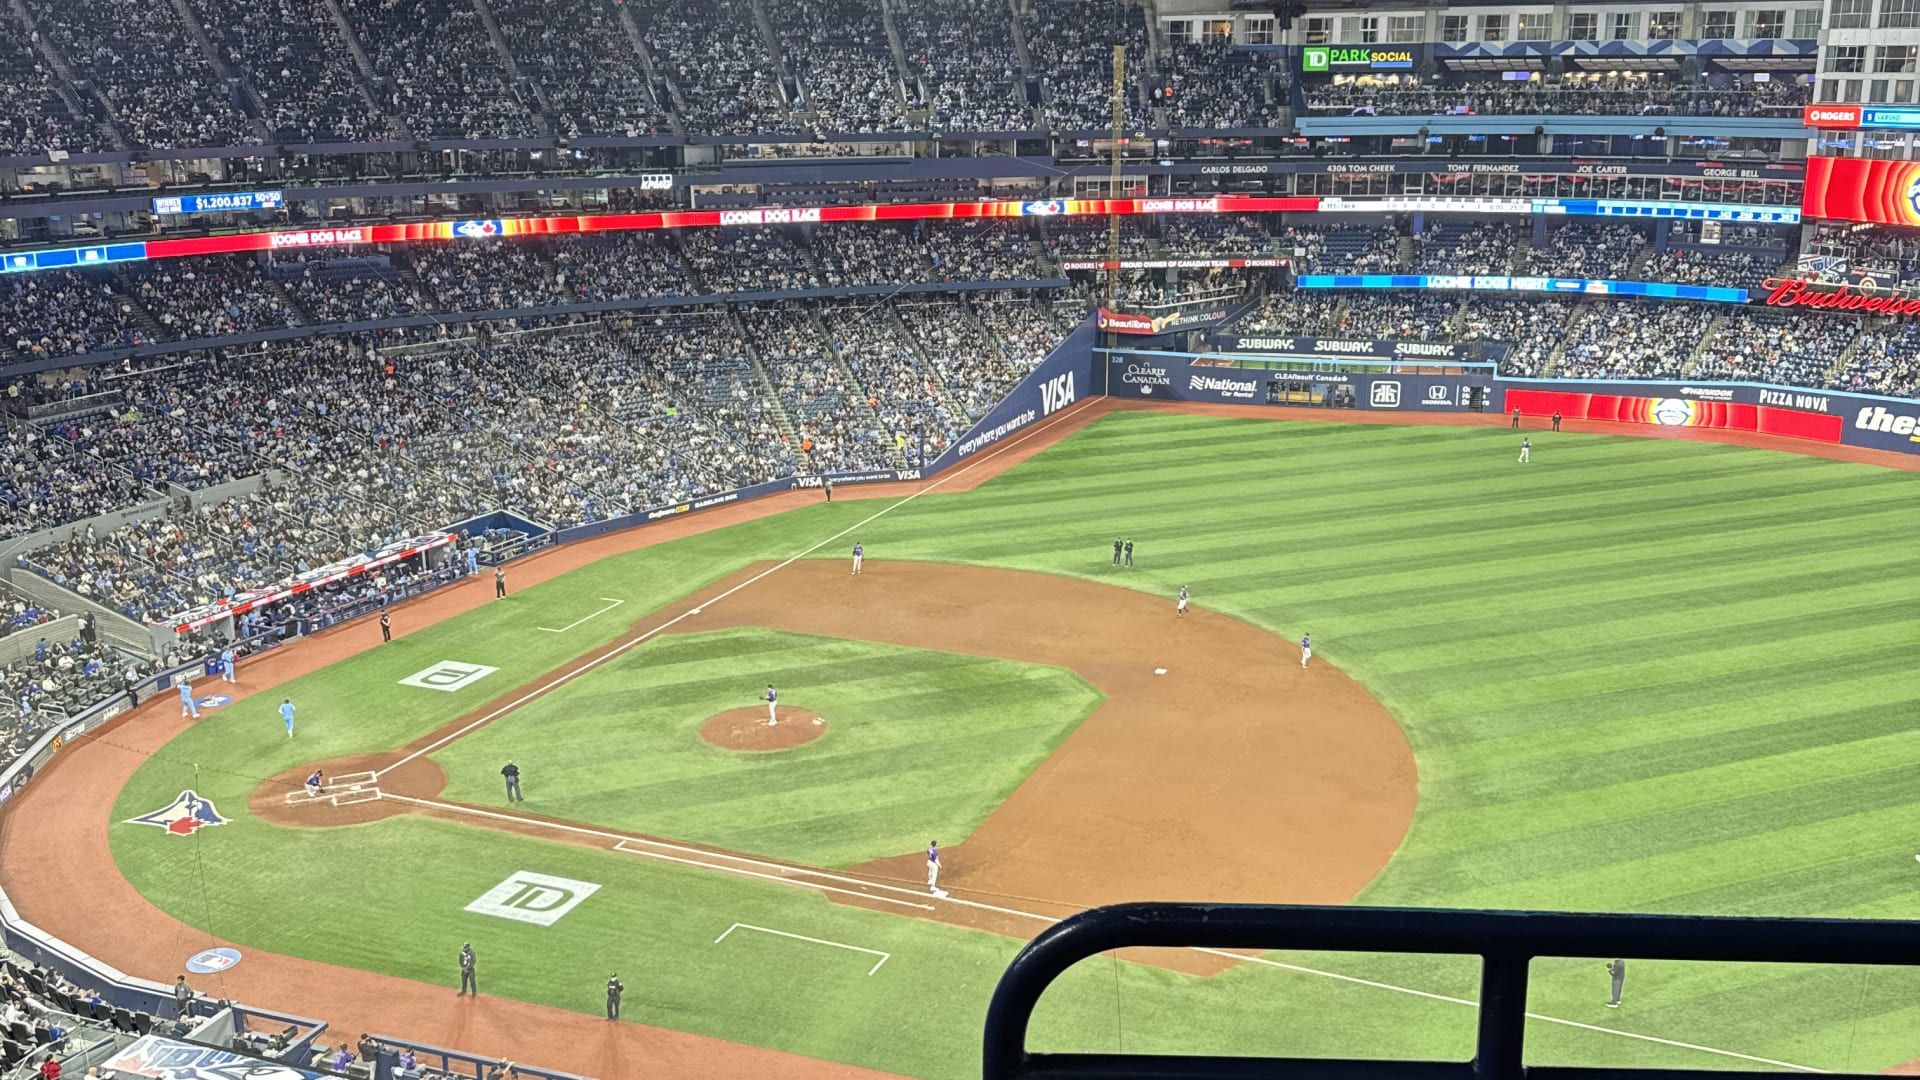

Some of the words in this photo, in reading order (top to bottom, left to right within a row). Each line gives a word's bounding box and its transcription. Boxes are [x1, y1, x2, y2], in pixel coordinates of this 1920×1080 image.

[1306, 52, 1327, 67] TD
[1331, 49, 1370, 61] PARK
[1371, 52, 1412, 61] SOCIAL
[1821, 112, 1854, 120] ROGERS
[1704, 168, 1737, 176] GEORGE
[1740, 170, 1759, 178] BELL
[641, 179, 672, 190] KPMG
[720, 210, 762, 225] LOONIE
[764, 210, 790, 223] DOG
[792, 208, 820, 222] RACE
[271, 232, 309, 246] LOONIE
[311, 232, 334, 243] DOG
[336, 230, 362, 241] RACE
[1511, 277, 1548, 290] NIGHT
[1171, 316, 1200, 326] RETHINK
[1200, 310, 1226, 321] COLOUR
[1236, 338, 1294, 350] SUBWAY
[1314, 340, 1374, 352] SUBWAY
[1394, 343, 1455, 356] SUBWAY
[1038, 370, 1075, 416] VISA
[1760, 389, 1793, 406] PIZZA
[1796, 394, 1828, 412] NOVA
[958, 429, 995, 456] everywhere
[995, 424, 1006, 440] you
[1006, 416, 1020, 432] want
[1020, 414, 1027, 424] to
[1028, 408, 1035, 422] be
[797, 476, 822, 488] VISA
[896, 470, 920, 480] VISA
[420, 668, 483, 686] TD
[500, 880, 576, 912] TD
